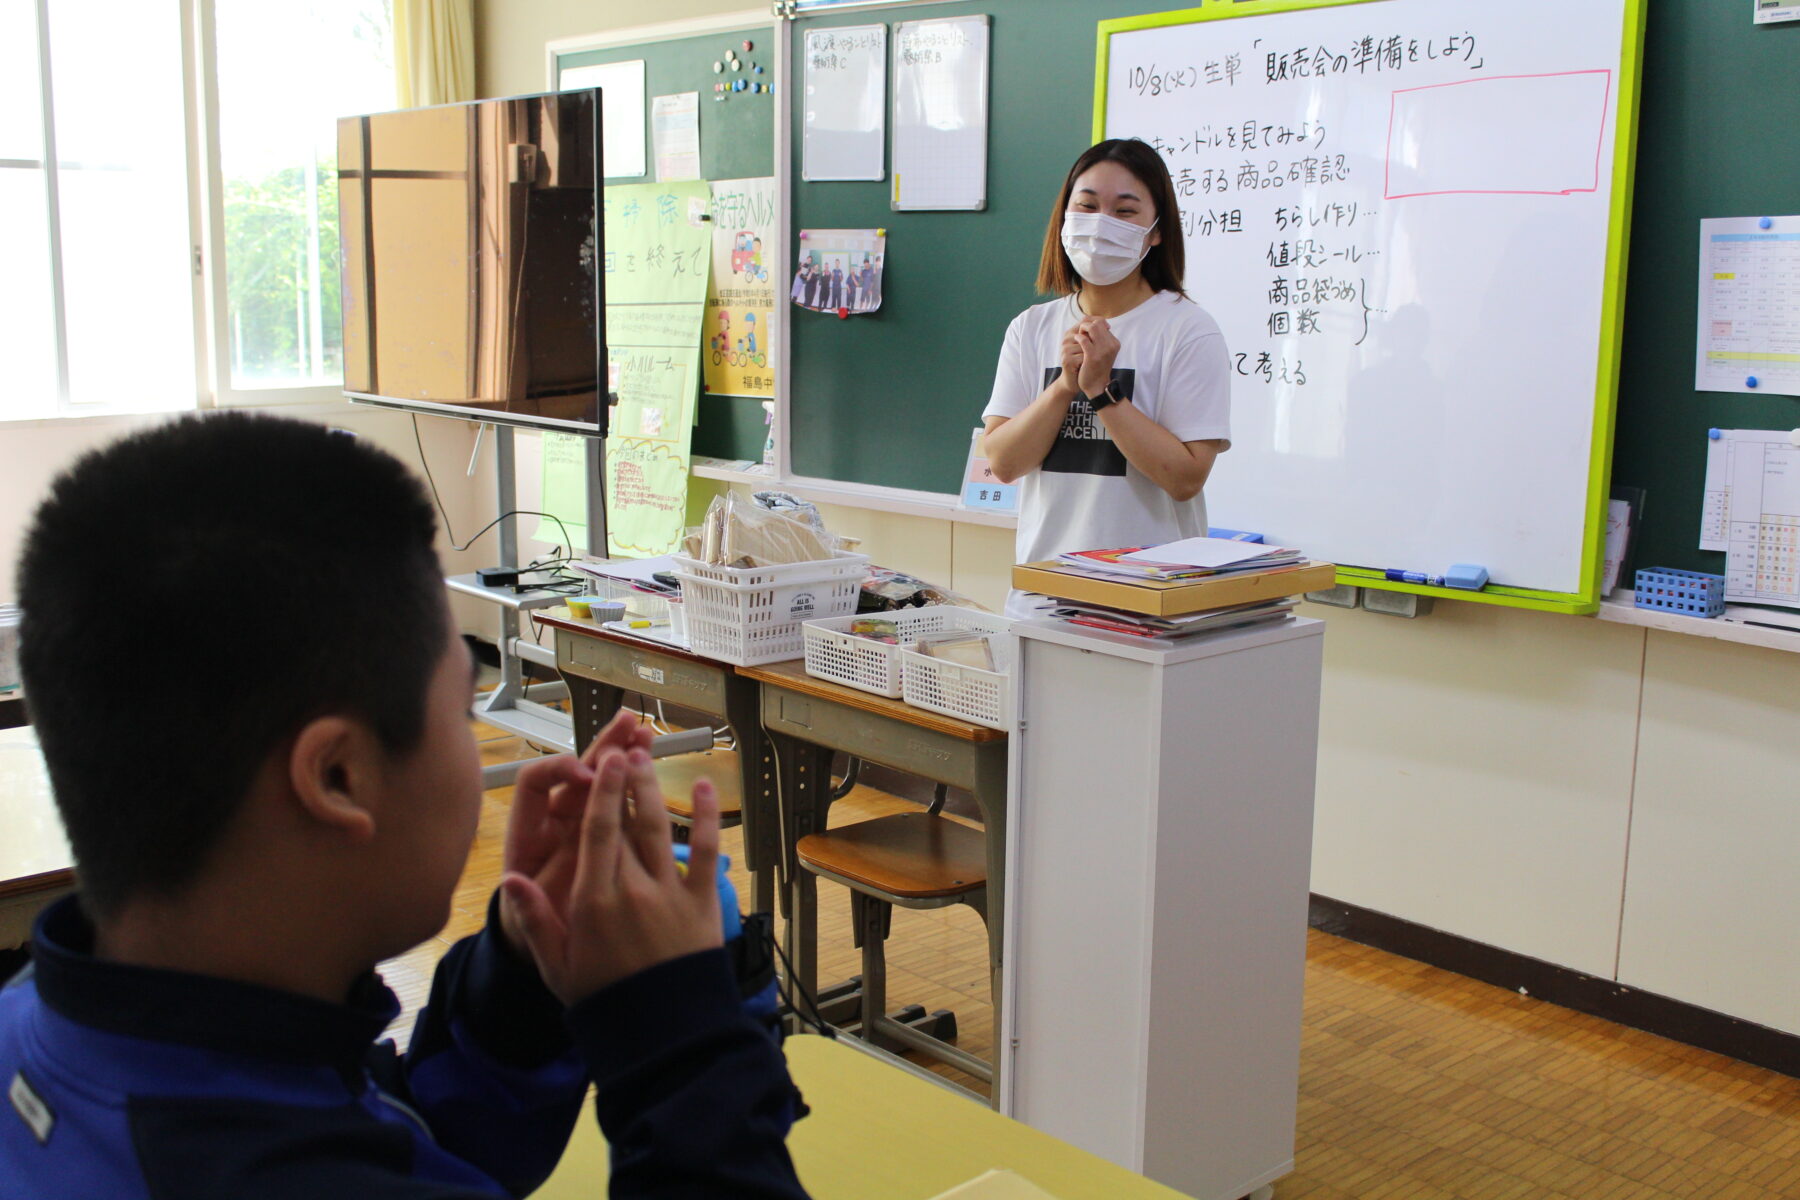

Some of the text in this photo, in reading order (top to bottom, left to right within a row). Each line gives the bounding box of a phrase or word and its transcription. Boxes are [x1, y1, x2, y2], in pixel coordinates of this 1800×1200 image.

[1267, 308, 1322, 338] 個数
[1229, 351, 1307, 386] て考える
